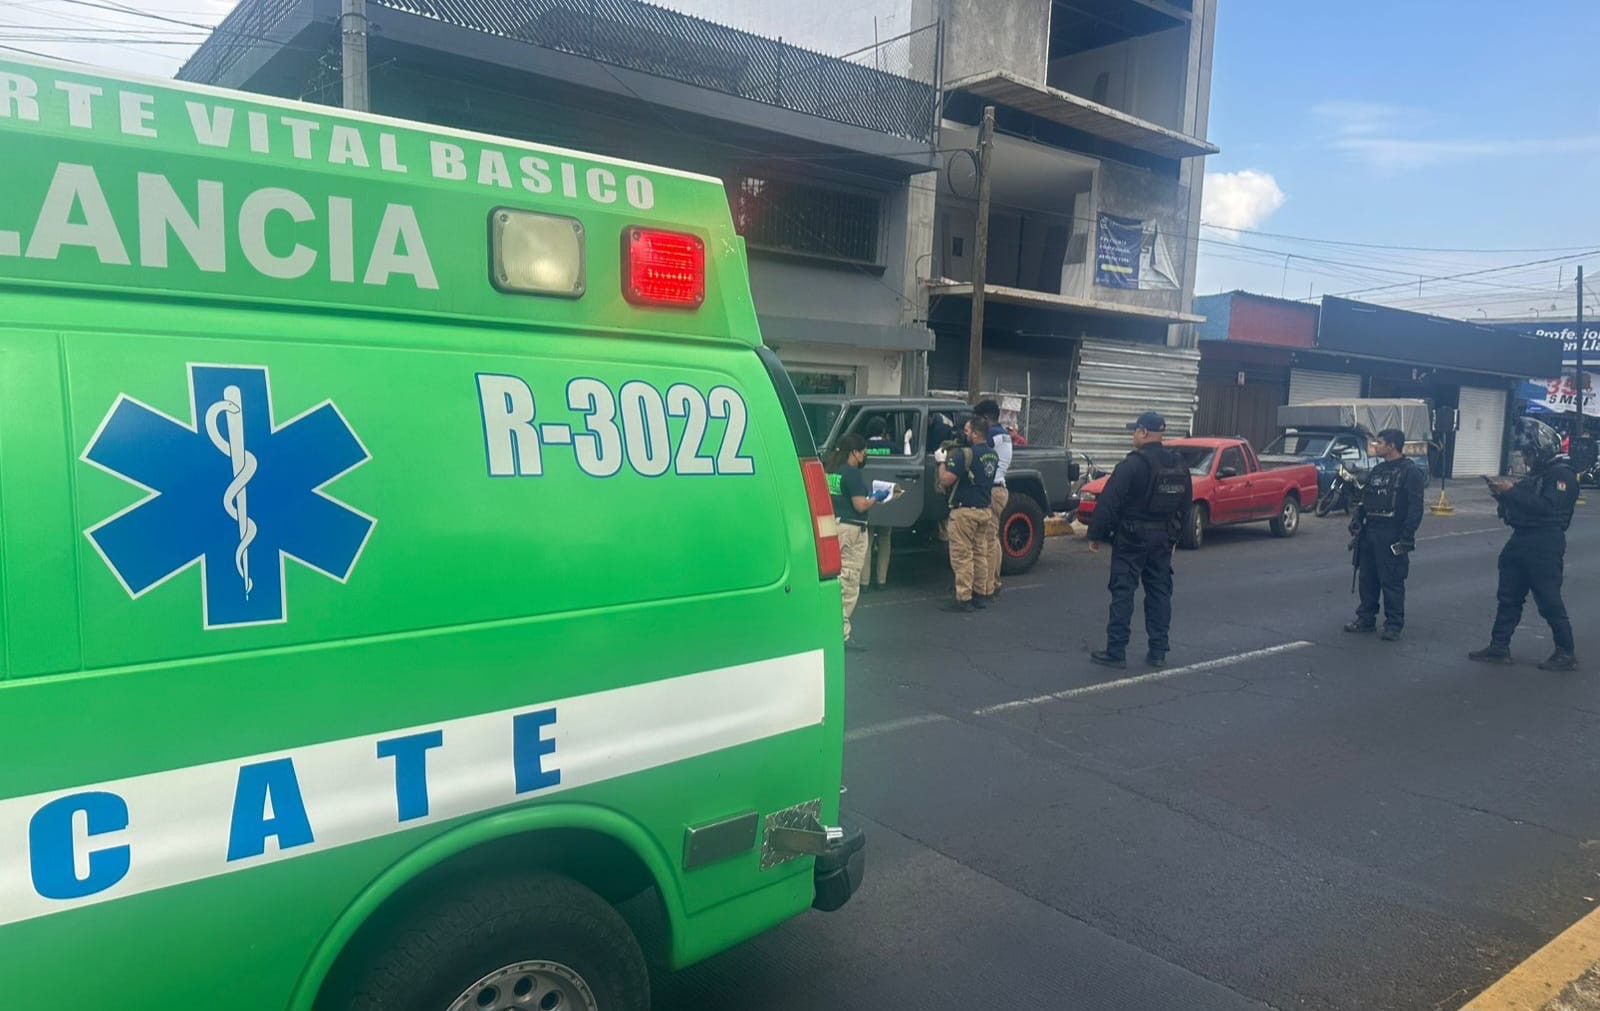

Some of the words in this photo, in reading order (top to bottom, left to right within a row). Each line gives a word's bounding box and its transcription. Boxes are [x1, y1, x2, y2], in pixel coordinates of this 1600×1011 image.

[0, 71, 158, 138] RTE
[185, 101, 408, 173] VITAL
[429, 140, 655, 210] BASICO
[1536, 328, 1600, 340] Profeio
[475, 372, 755, 478] R-3022
[29, 707, 561, 900] CATE
